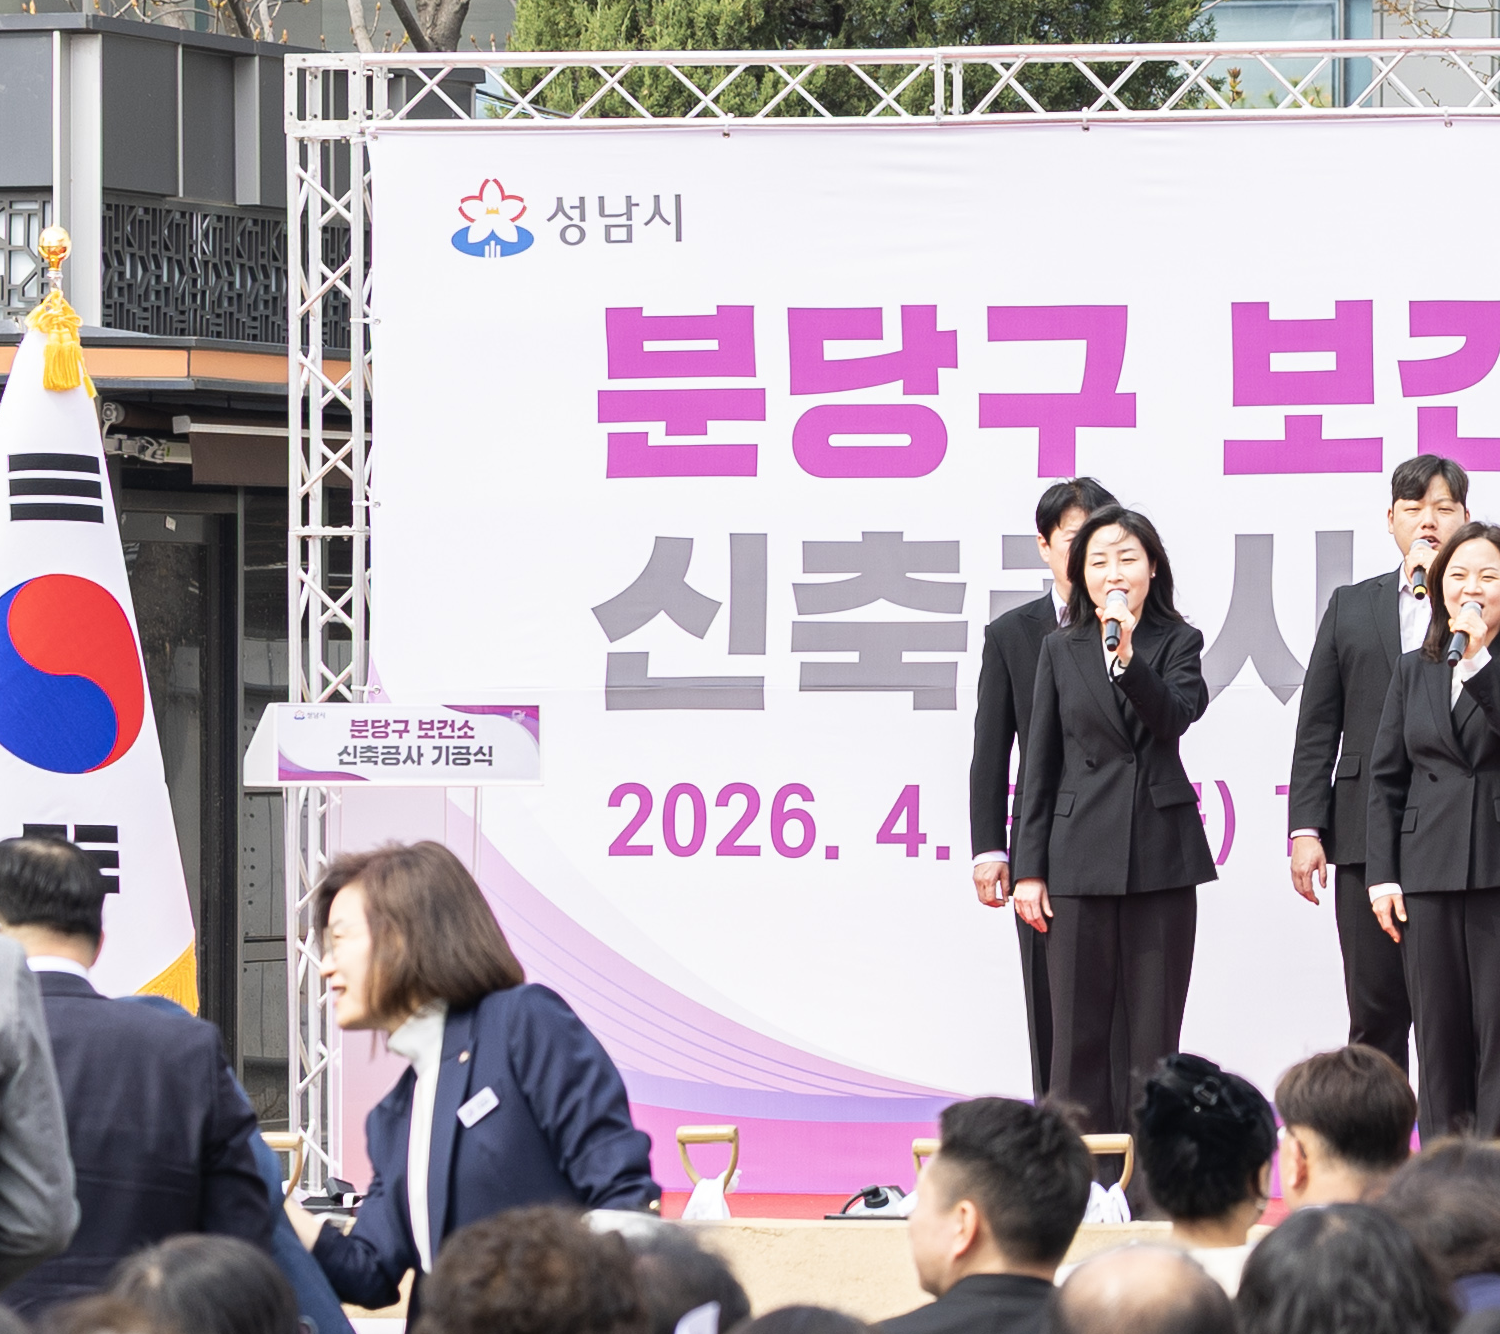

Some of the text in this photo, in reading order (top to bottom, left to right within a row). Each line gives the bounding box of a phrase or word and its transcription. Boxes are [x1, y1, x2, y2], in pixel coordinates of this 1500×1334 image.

[546, 193, 682, 246] 성남시
[597, 303, 1137, 479] 분당구
[349, 719, 475, 740] 분당구 보건소
[337, 745, 493, 768] 신축공사 기공식
[607, 782, 839, 861] 2026.
[876, 783, 951, 861] 4.
